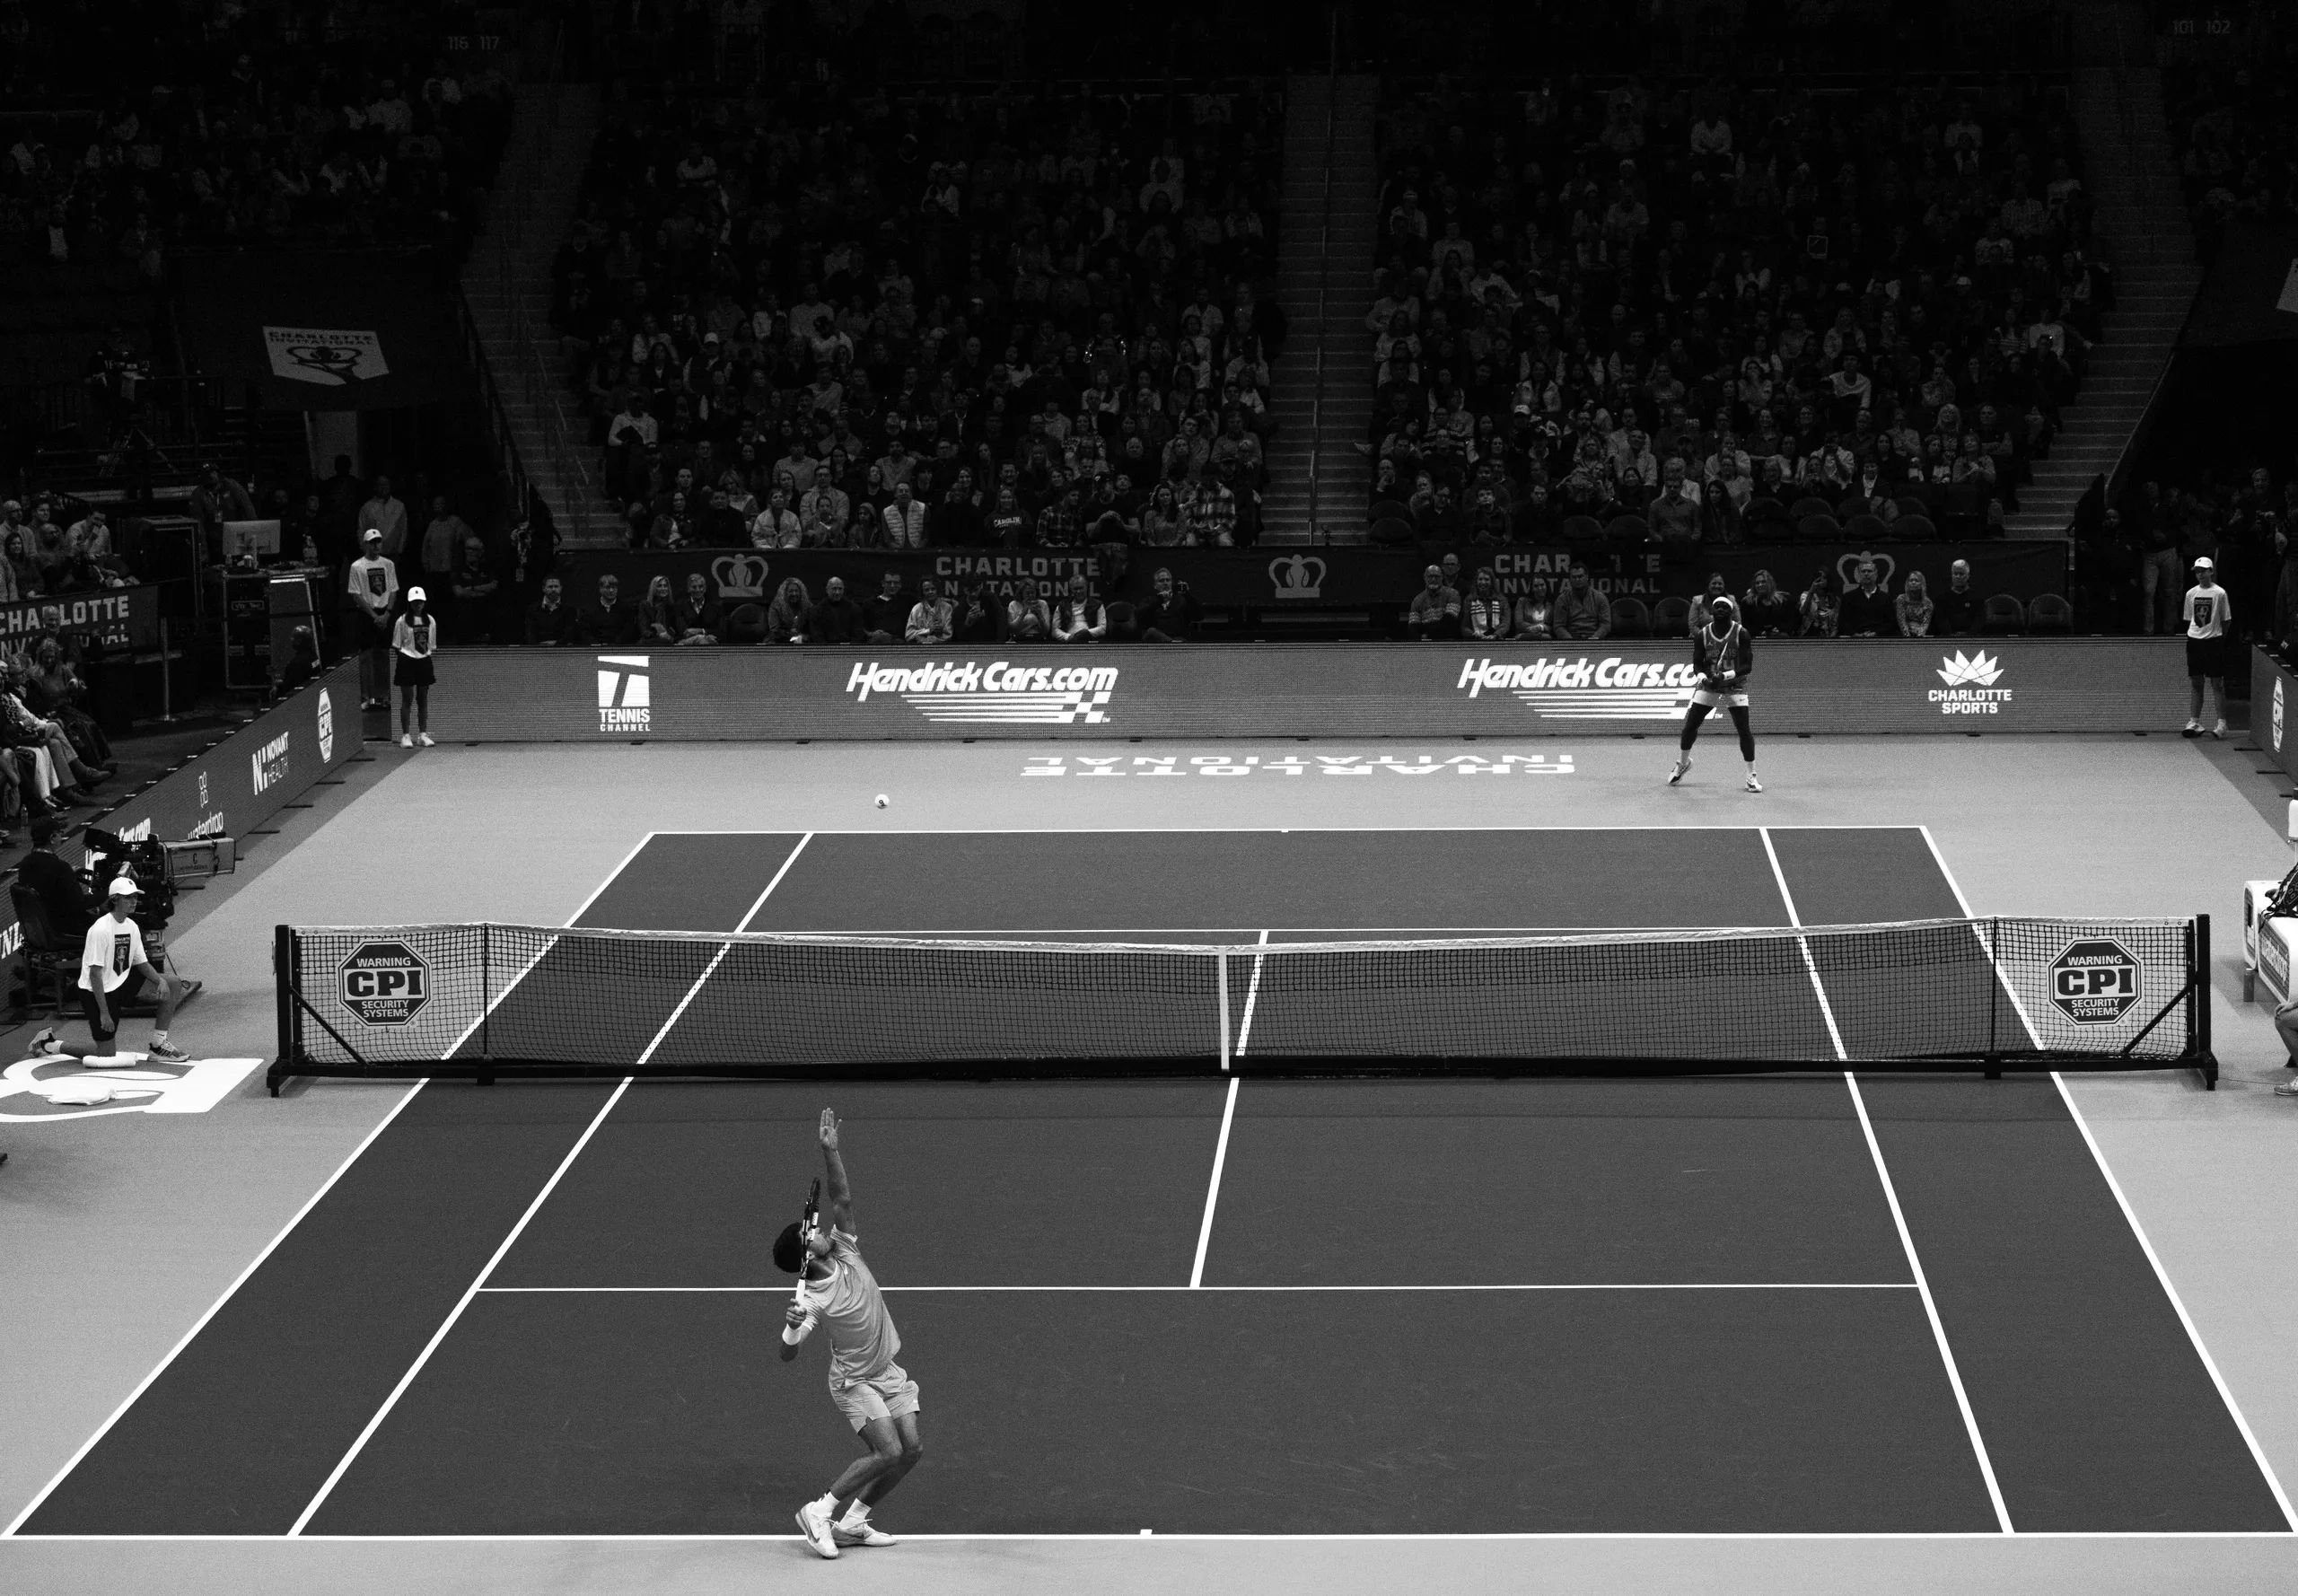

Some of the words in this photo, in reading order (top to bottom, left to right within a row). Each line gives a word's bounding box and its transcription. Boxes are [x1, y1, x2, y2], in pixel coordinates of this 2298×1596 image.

[479, 35, 500, 50] 117
[993, 516, 1022, 528] CAROLIN
[935, 557, 1101, 576] CHARLOTTE
[1927, 689, 2013, 702] CHARLOTTE
[1942, 702, 1998, 715] SPORTS
[599, 708, 650, 723] TENNIS
[600, 723, 651, 732] CHANNEL
[267, 731, 289, 764] NOVANT
[356, 957, 411, 967] WARNING
[2067, 955, 2123, 966] WARNING
[347, 970, 422, 996] CPI
[2057, 969, 2133, 995] CPI
[362, 1000, 409, 1009] SECURITY
[2072, 998, 2119, 1008] SECURITY
[364, 1009, 409, 1018] SYSTEMS
[2073, 1007, 2119, 1017] SYSTEMS
